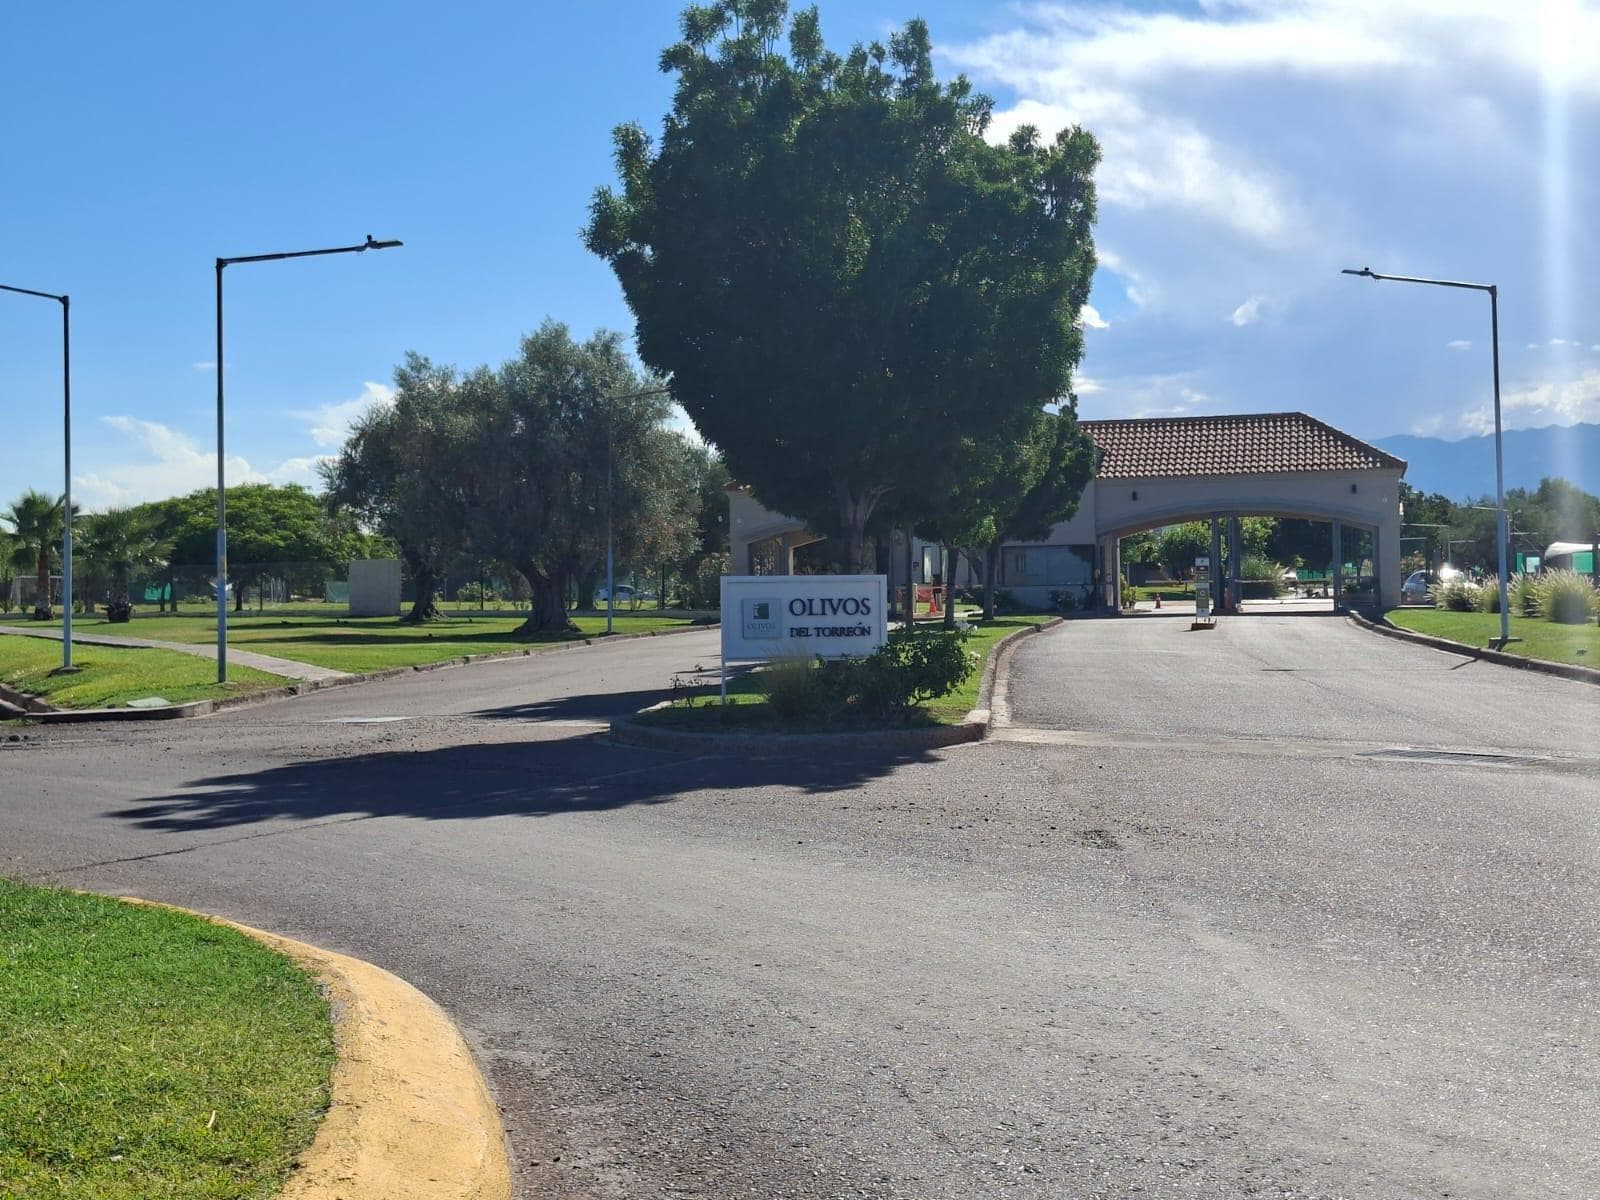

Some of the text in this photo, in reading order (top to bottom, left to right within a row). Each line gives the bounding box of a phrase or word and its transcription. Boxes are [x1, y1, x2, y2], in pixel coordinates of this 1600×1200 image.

[789, 598, 871, 616] OLIVOS
[790, 622, 871, 638] DEL TORREÓN
